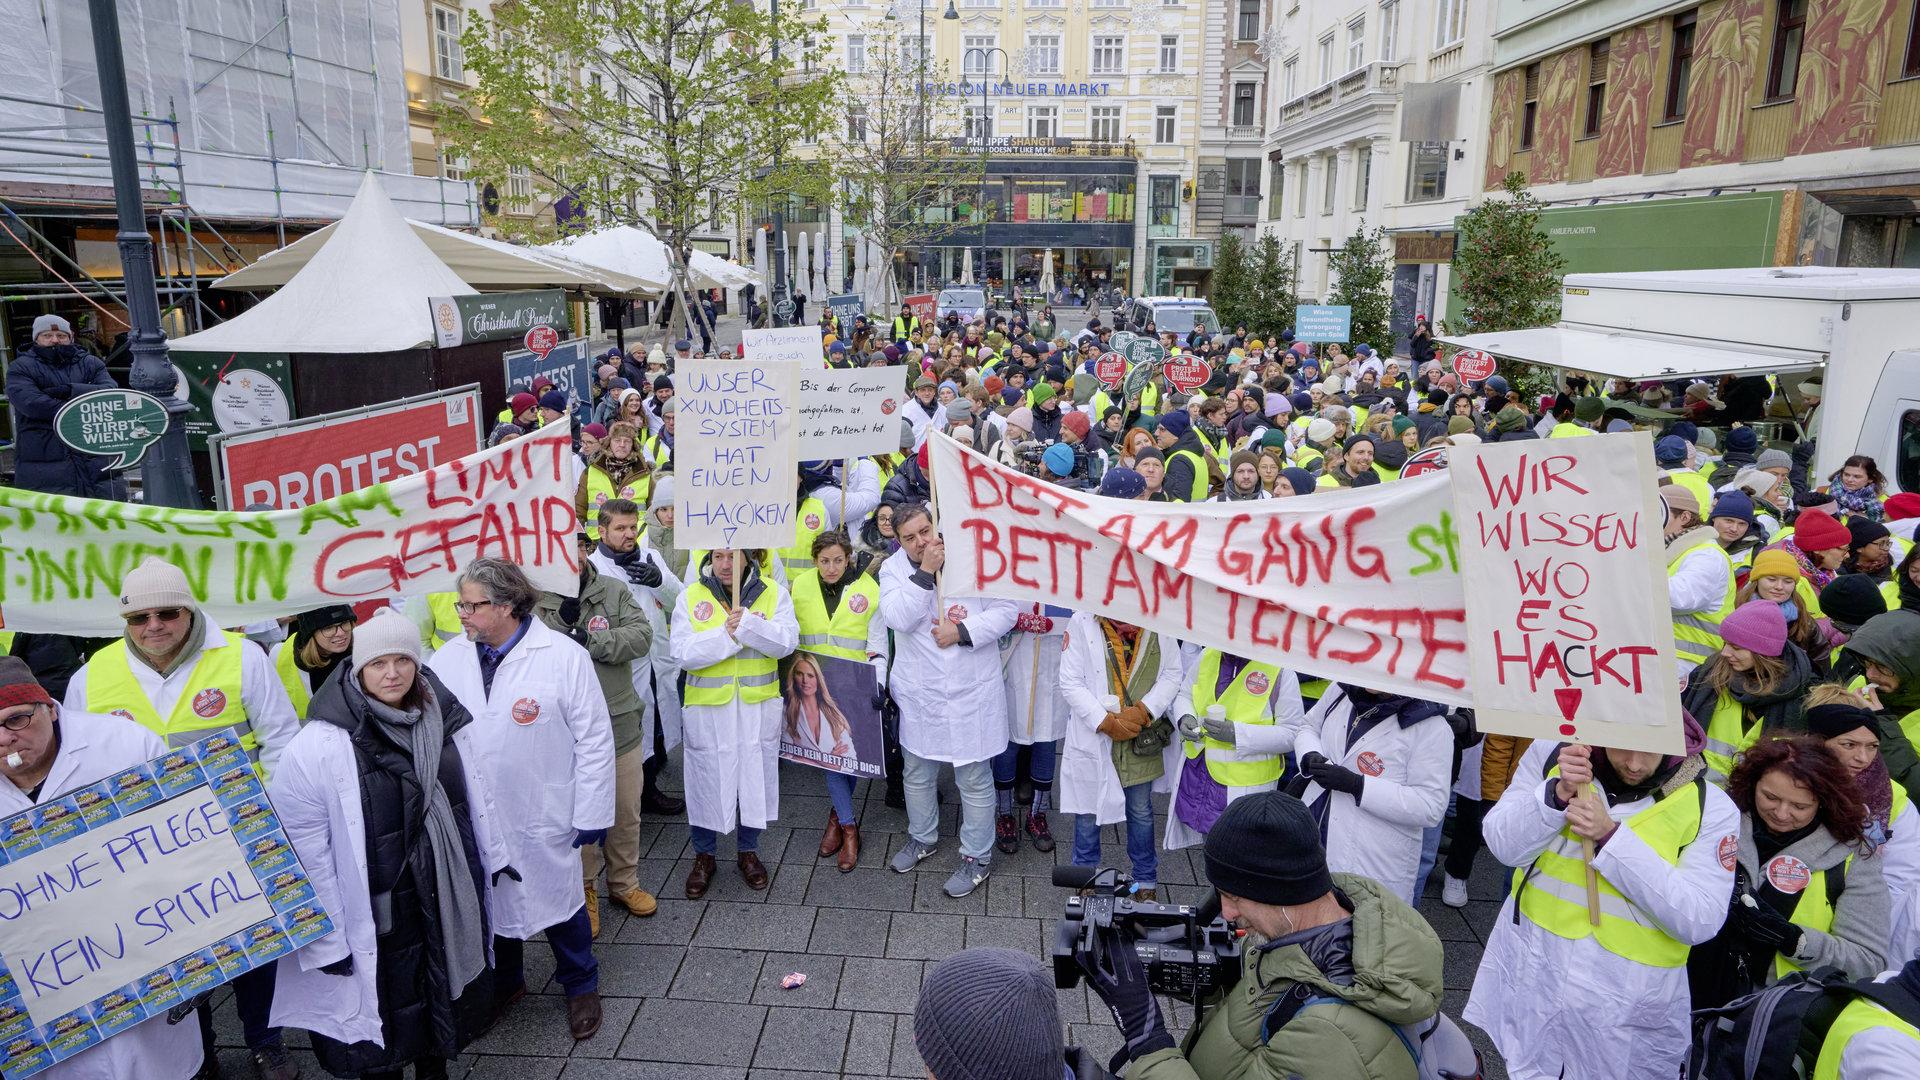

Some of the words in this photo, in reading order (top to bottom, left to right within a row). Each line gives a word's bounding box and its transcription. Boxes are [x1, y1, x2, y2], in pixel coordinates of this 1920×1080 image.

[915, 83, 987, 96] PENSION
[994, 83, 1047, 96] NEUER
[1055, 83, 1110, 95] MARKT
[967, 137, 1009, 146] PHIIPPE
[1011, 137, 1056, 146] SHANGTI
[480, 303, 497, 311] WIENER
[848, 302, 861, 314] UNS
[468, 308, 522, 339] Christkindl
[522, 306, 554, 327] Punsch
[1171, 365, 1201, 373] PROTEST
[1458, 367, 1487, 377] BURNOUT
[1460, 362, 1478, 370] STATT
[1461, 357, 1488, 366] PROTEST
[688, 368, 776, 394] UNSER
[800, 379, 819, 391] Bis
[827, 380, 842, 392] der
[849, 382, 887, 397] Computer
[1171, 375, 1202, 383] BURNOUT
[80, 400, 124, 413] OHNE
[81, 411, 114, 424] UNS
[82, 419, 135, 434] STIRBT
[83, 431, 129, 445] WIEN.
[699, 419, 777, 441] SYSTEM
[797, 428, 806, 438] st
[813, 427, 825, 437] der
[831, 425, 867, 436] Patient
[714, 446, 765, 466] HAT
[425, 435, 571, 509] LIMIT
[691, 467, 771, 488] EINEN
[1477, 453, 1590, 510] WIR
[685, 499, 791, 528] HA(C)KEN
[1477, 510, 1639, 552] WISSEN
[235, 540, 293, 604] IN
[313, 496, 580, 597] GEFAHR
[1218, 507, 1391, 586] GANG
[961, 517, 1093, 600] BETT
[1103, 542, 1194, 630] AM
[1514, 556, 1590, 599] WO
[1516, 599, 1598, 641] ES
[1493, 630, 1658, 694] HACKT
[780, 742, 803, 757] EIDER
[803, 748, 822, 762] KEIN
[822, 753, 842, 766] BETT
[843, 756, 859, 770] FÜR
[860, 761, 881, 775] DICH
[0, 852, 102, 920] OHNE
[101, 801, 228, 873] PFLEGE
[21, 922, 125, 997] KEIN
[134, 870, 262, 946] SPITAL
